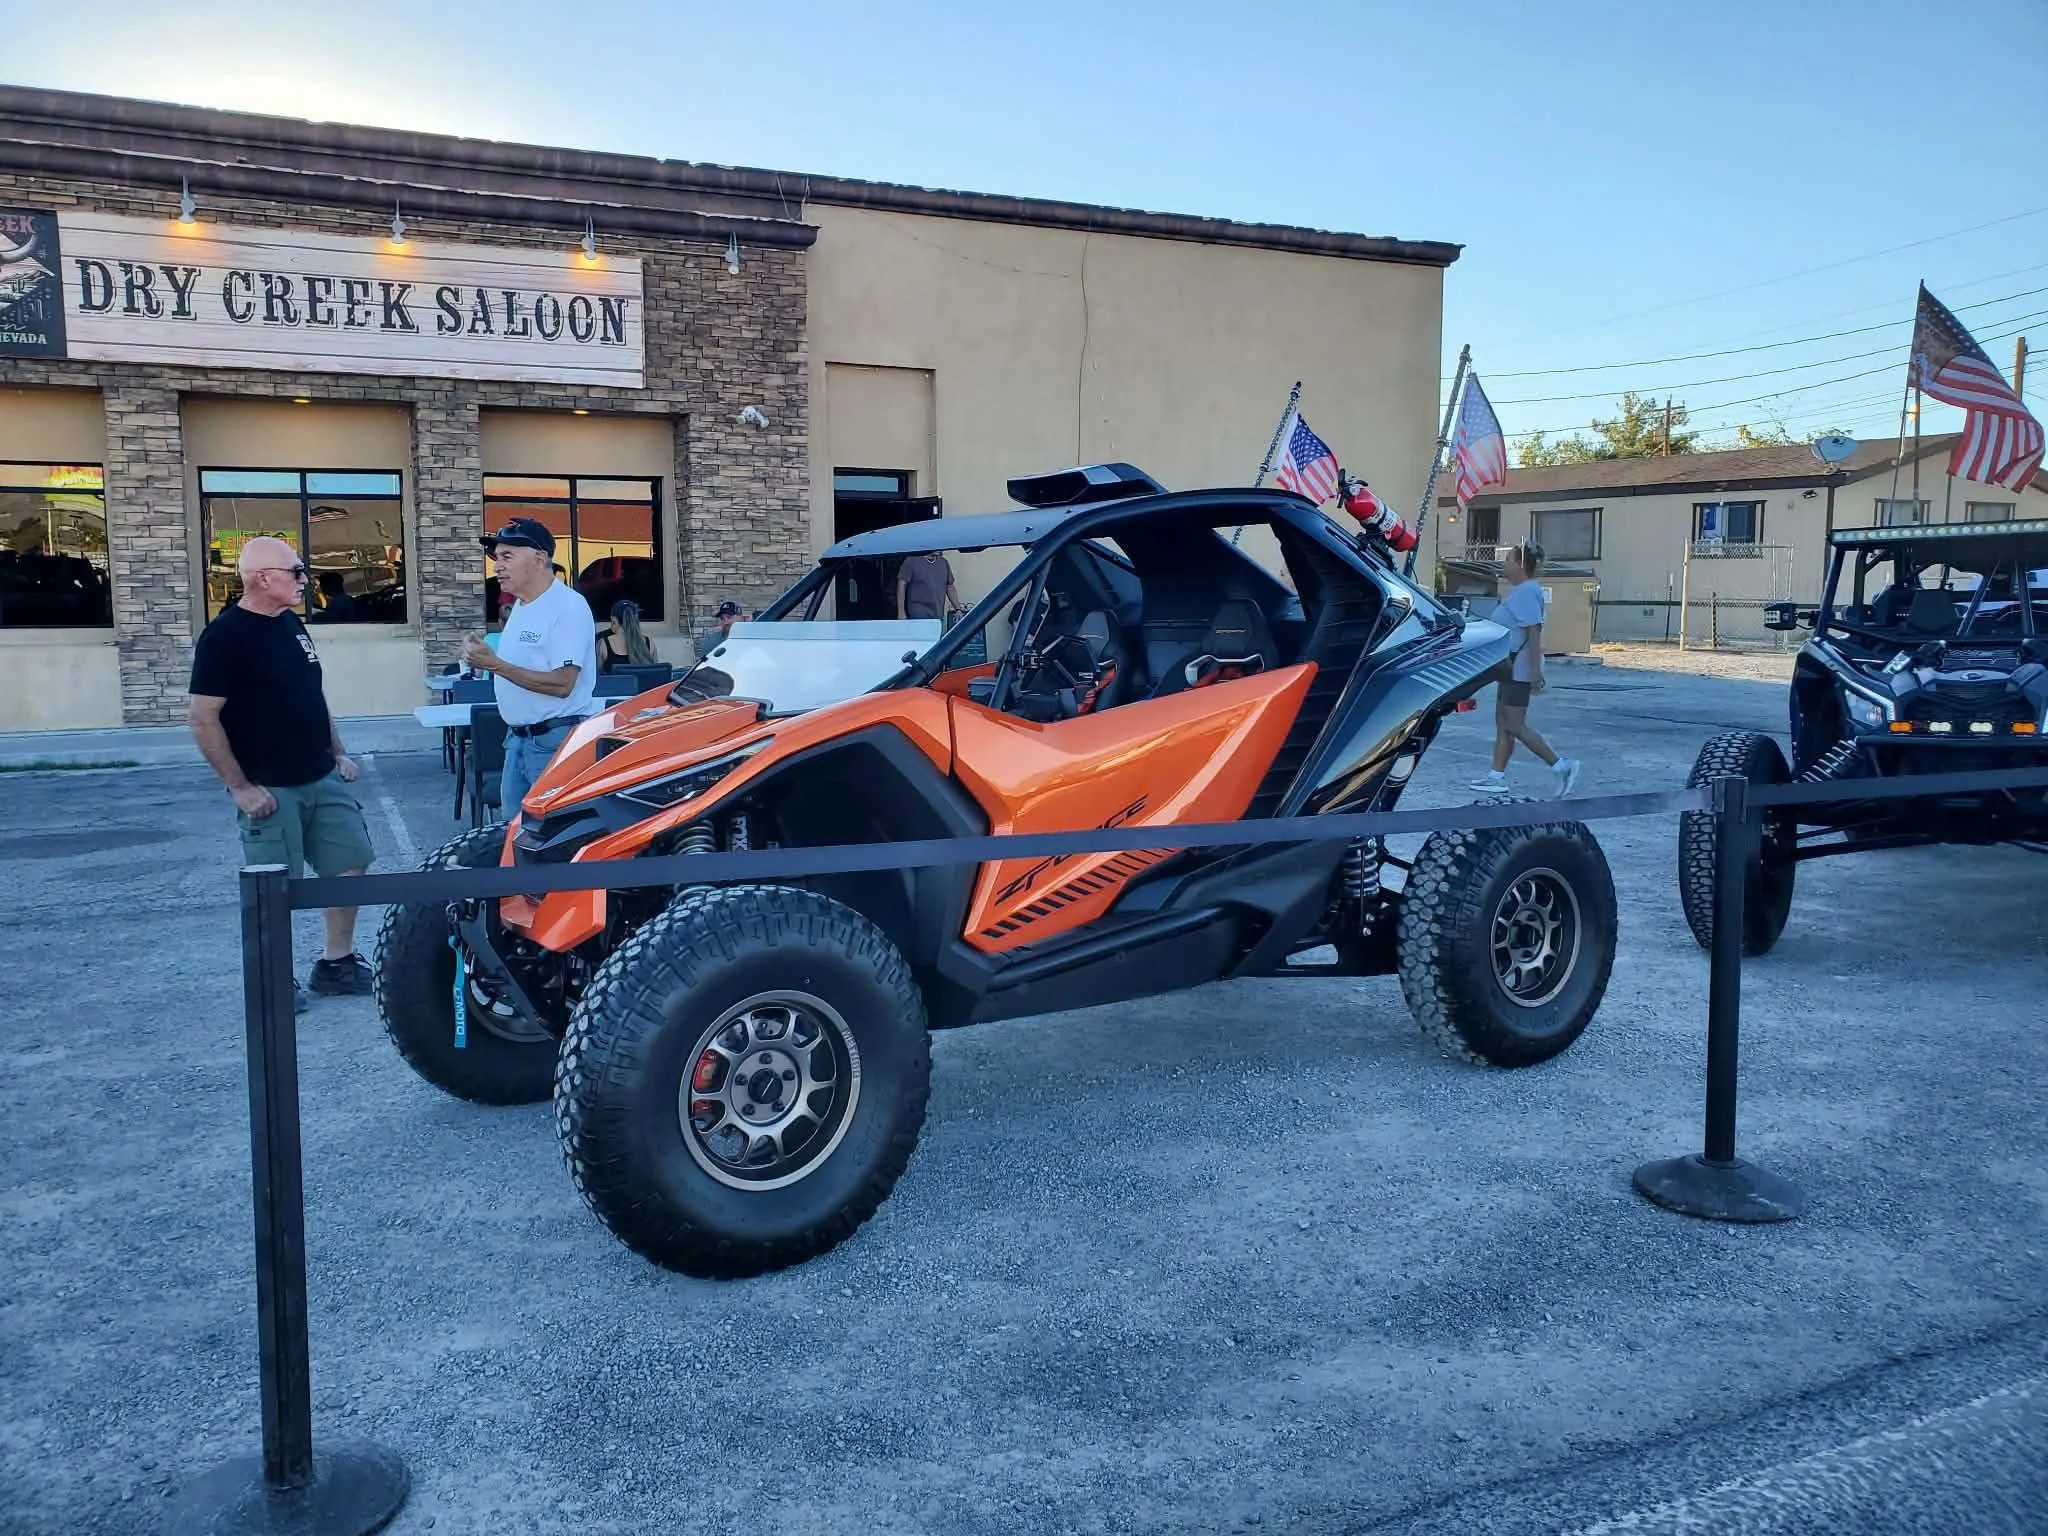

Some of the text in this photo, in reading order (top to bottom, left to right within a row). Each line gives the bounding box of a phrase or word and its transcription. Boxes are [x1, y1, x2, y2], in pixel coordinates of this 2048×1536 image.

[75, 259, 628, 345] DRY CREEK SALOON
[0, 331, 47, 345] EVADA
